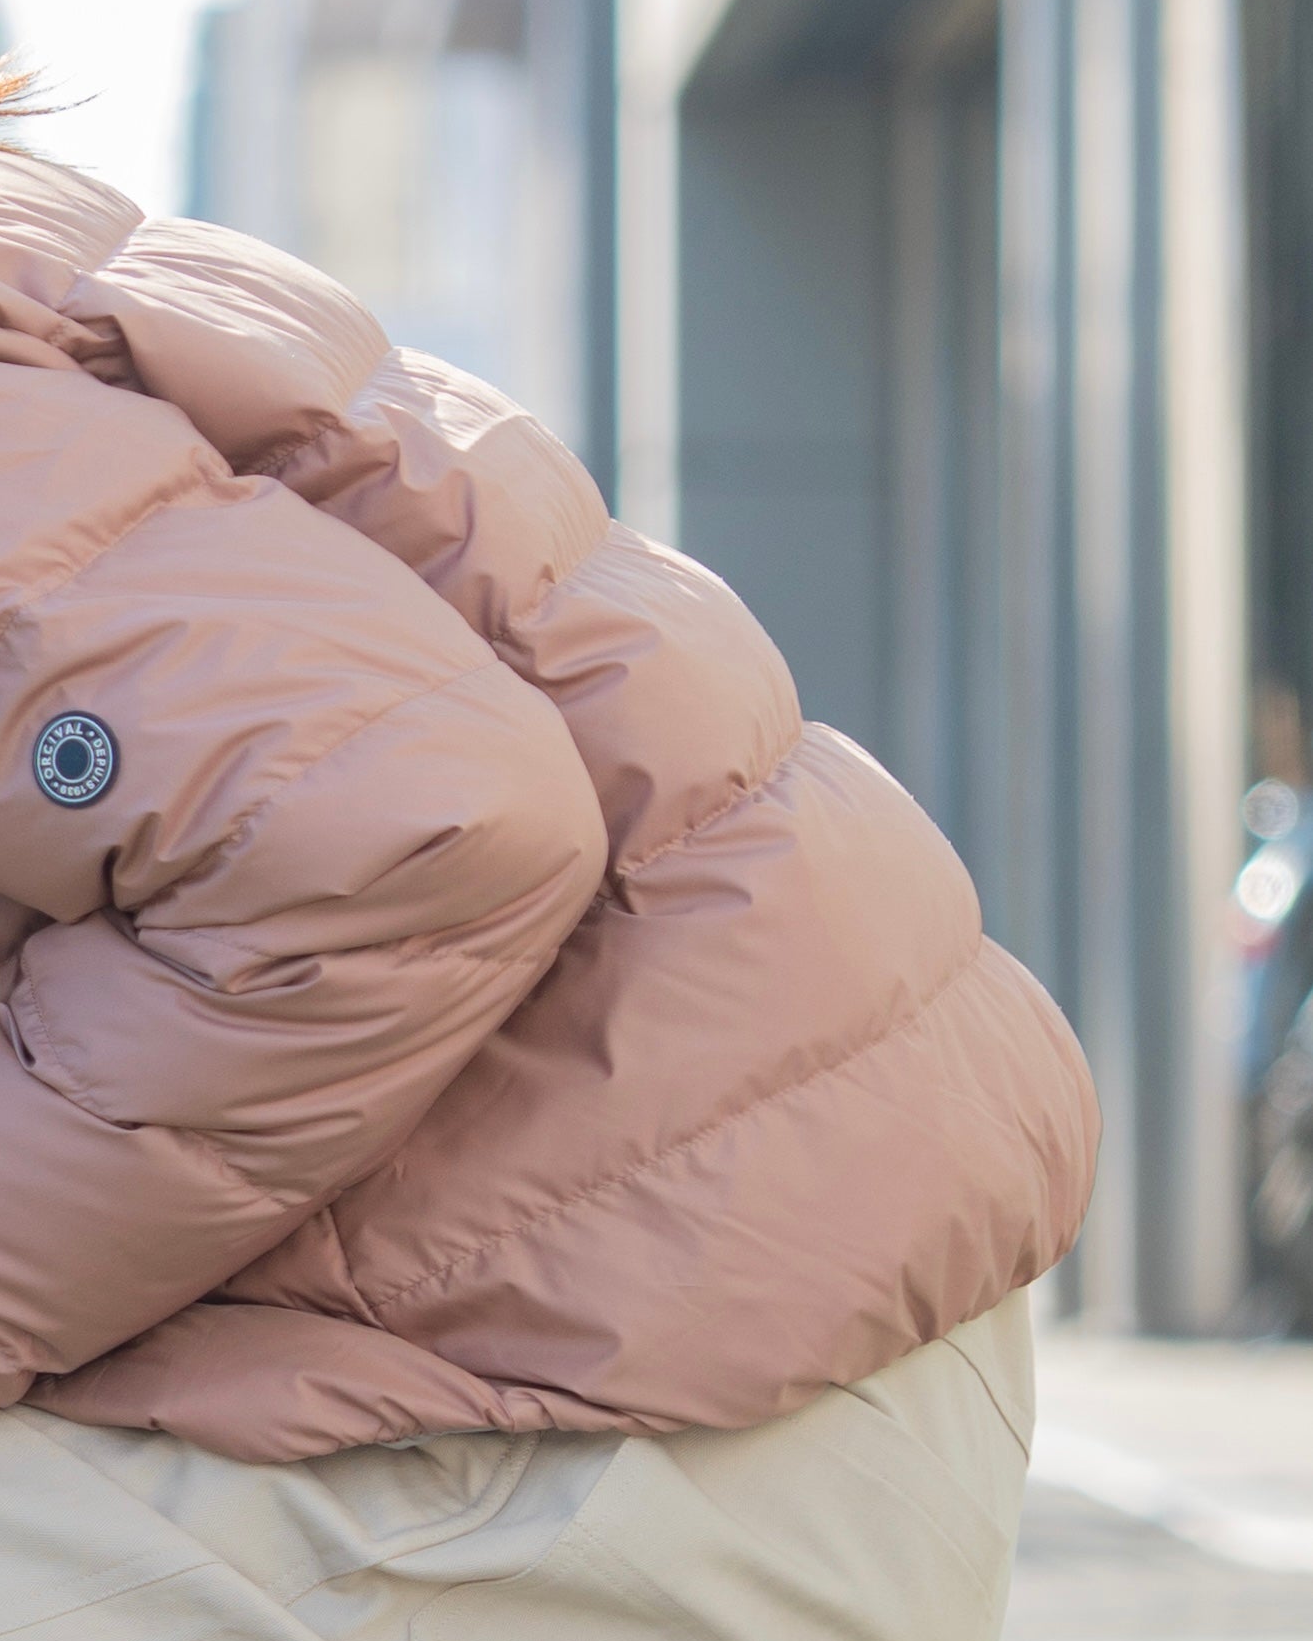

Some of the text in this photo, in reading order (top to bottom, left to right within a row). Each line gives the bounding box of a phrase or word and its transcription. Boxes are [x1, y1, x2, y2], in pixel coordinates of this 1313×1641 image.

[41, 722, 107, 796] ORCIVAL DEPUIS 1939
